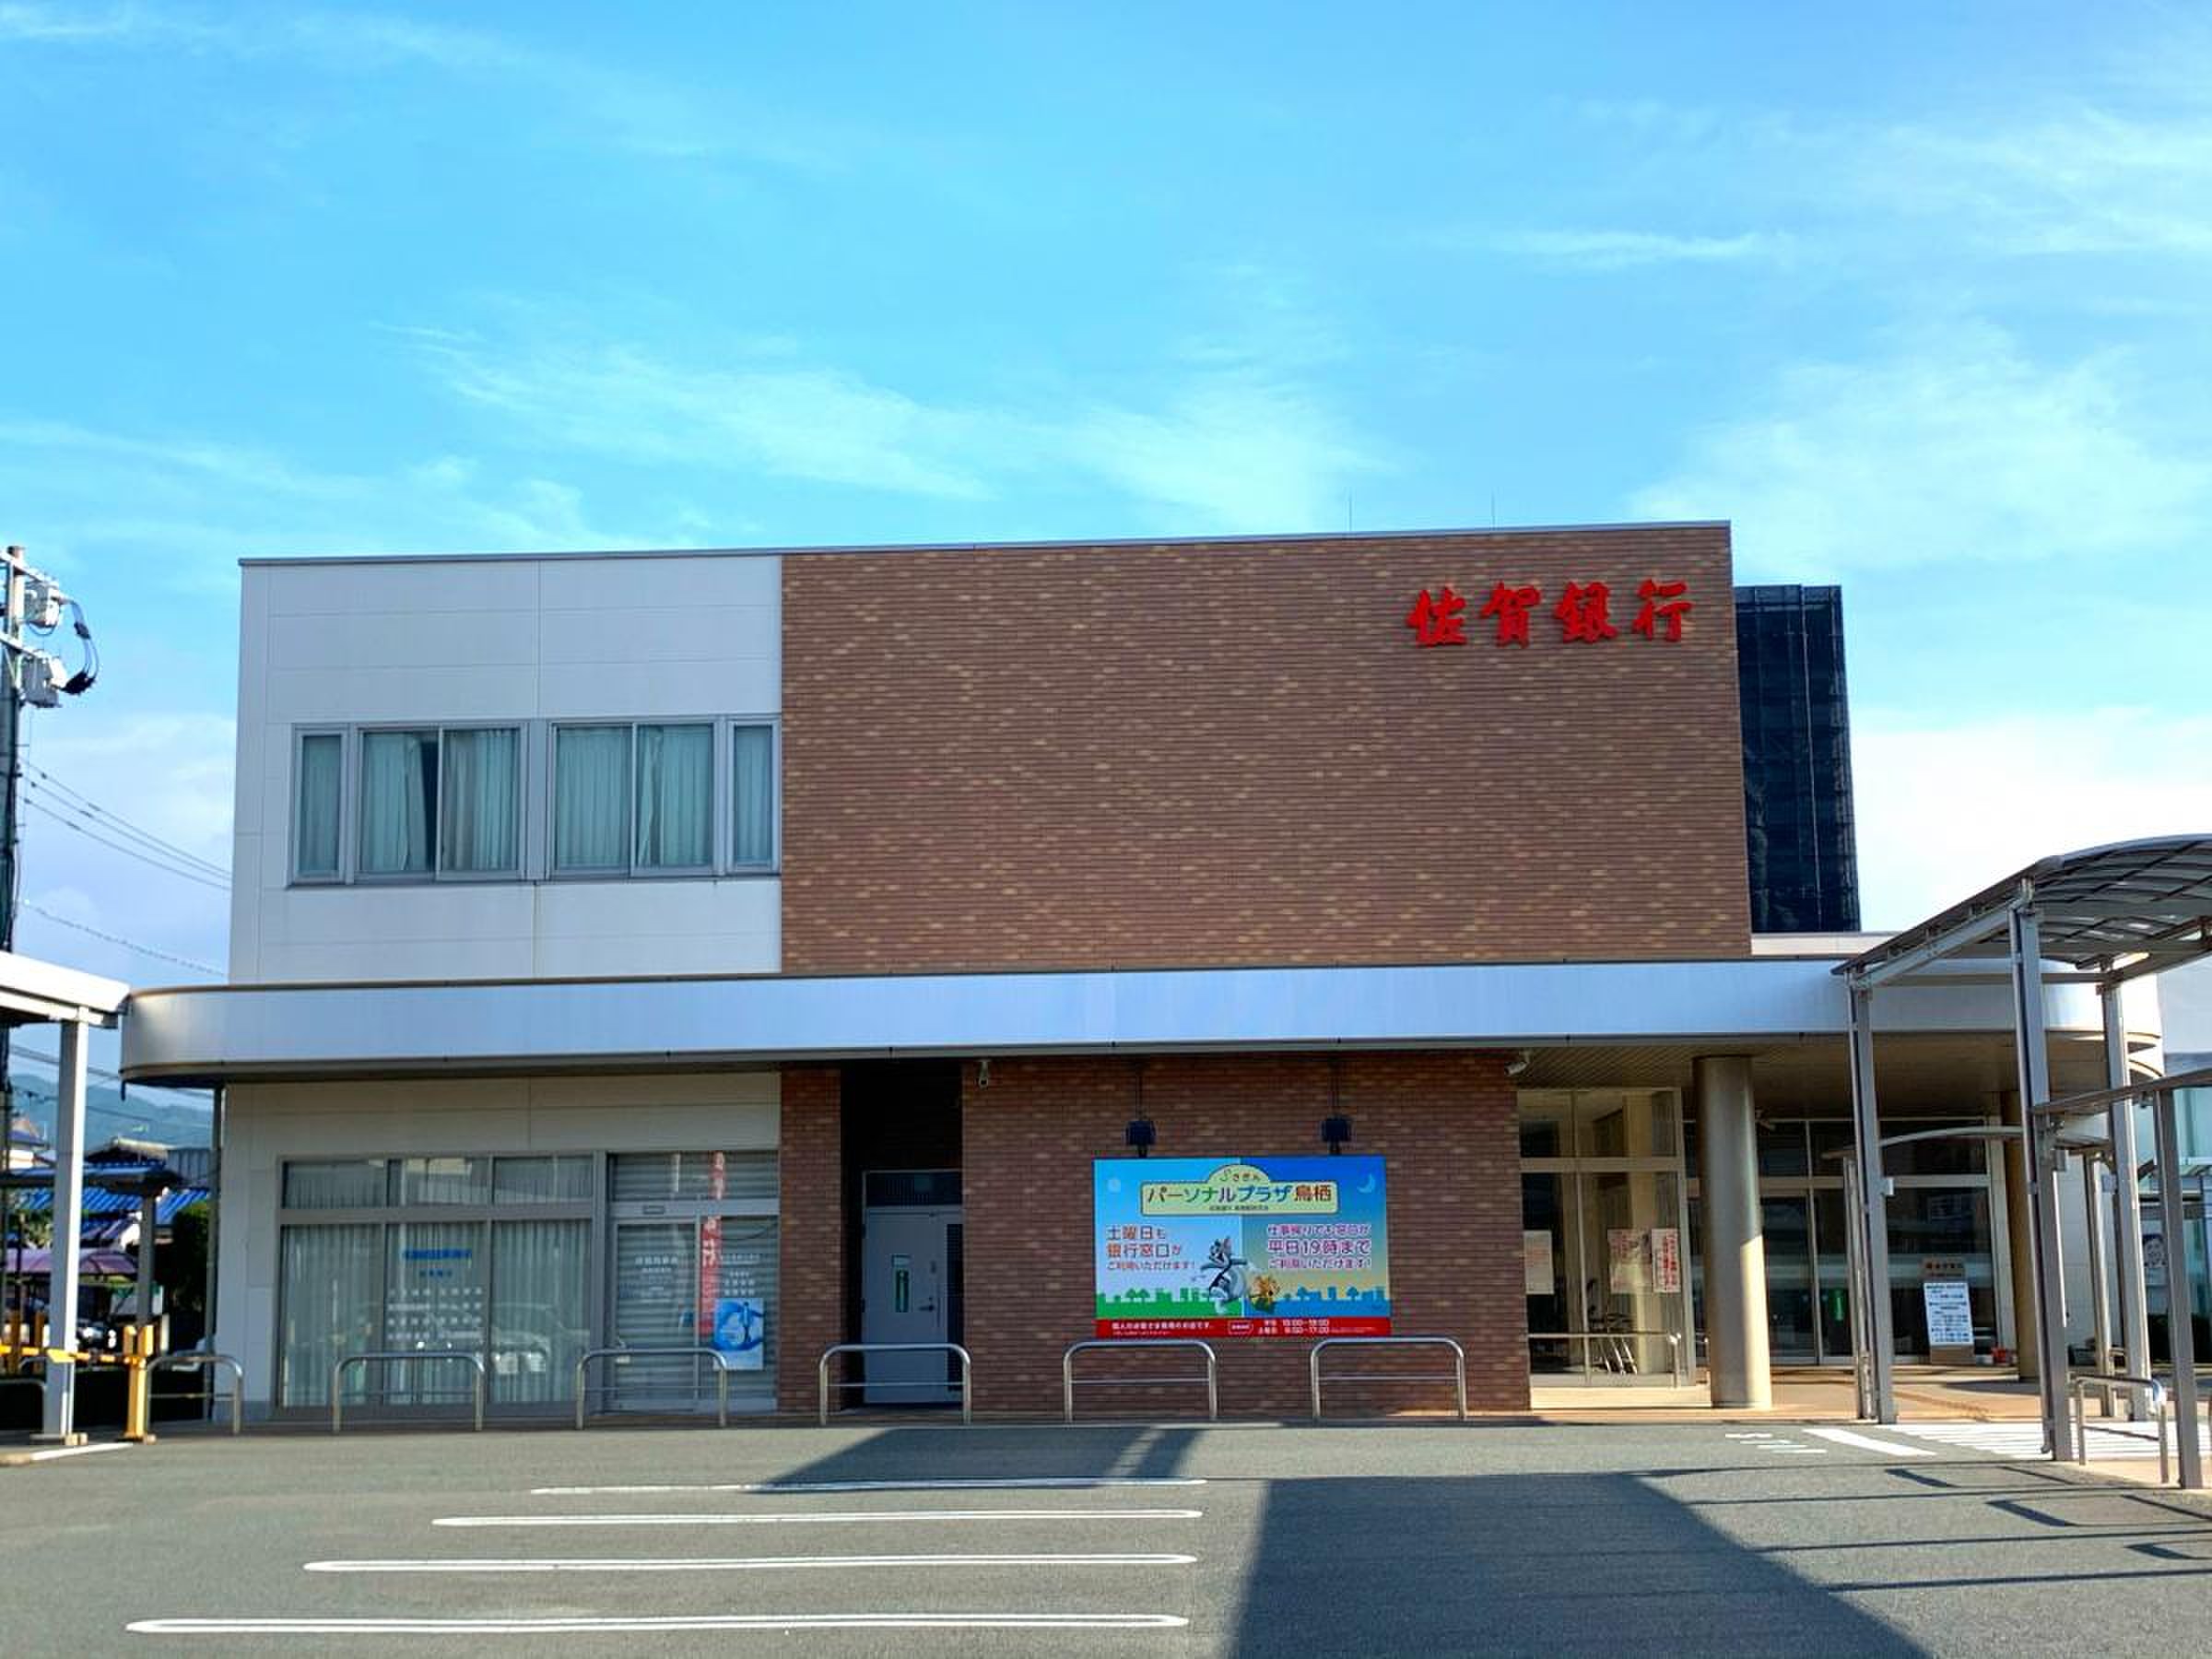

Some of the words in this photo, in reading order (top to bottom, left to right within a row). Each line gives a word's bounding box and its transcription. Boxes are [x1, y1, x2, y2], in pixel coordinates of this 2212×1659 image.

[1406, 579, 1693, 648] 佐賀銀行
[1147, 1183, 1332, 1204] パーソナルプラザ鳥栖
[1107, 1224, 1167, 1240] 土曜日も
[1107, 1241, 1182, 1259] 銀行窓口が
[1267, 1239, 1371, 1255] 平日19時まで
